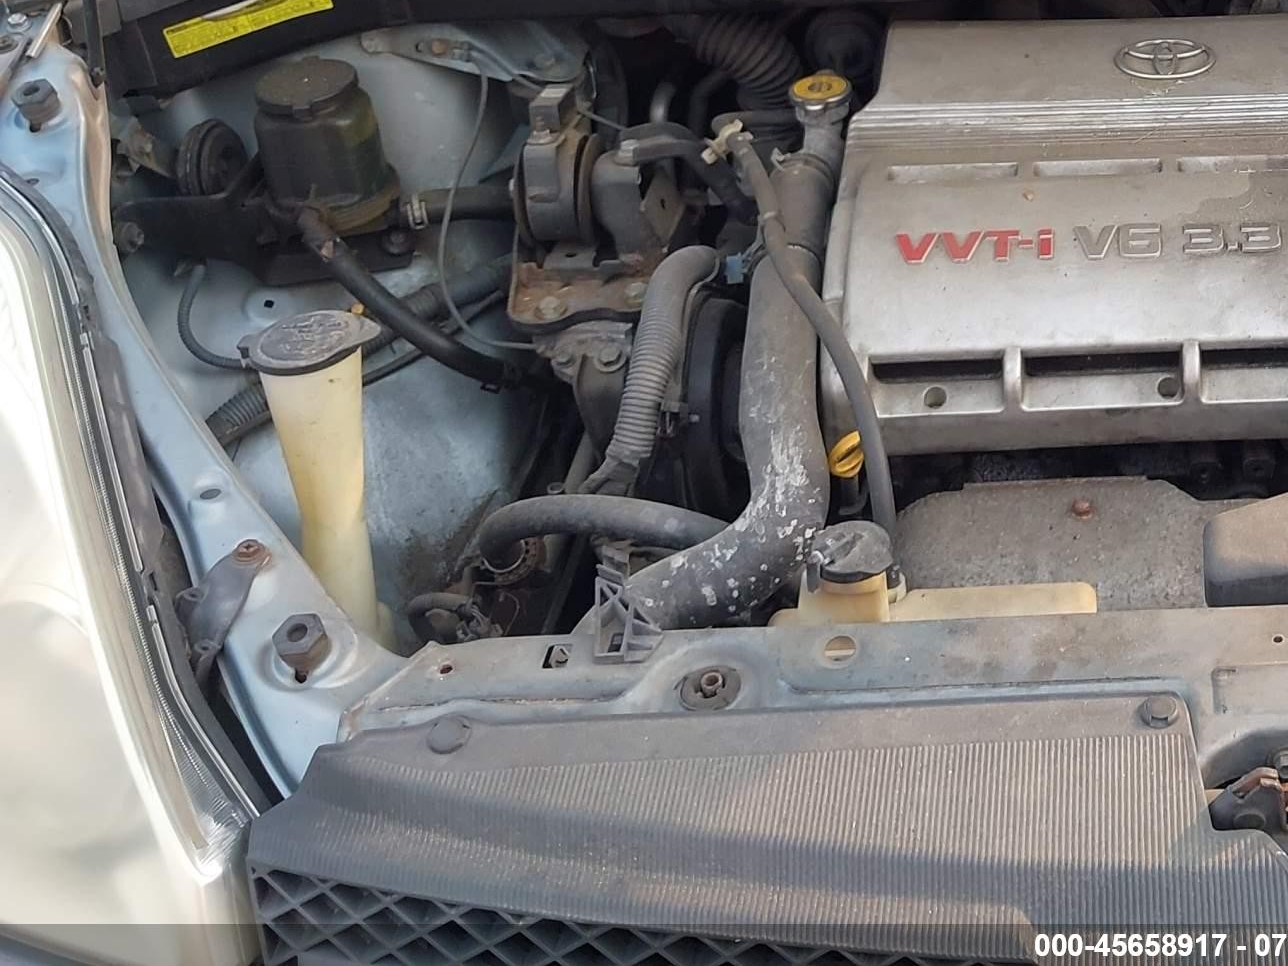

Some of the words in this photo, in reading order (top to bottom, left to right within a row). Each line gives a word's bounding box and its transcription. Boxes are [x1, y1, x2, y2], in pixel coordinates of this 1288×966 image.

[896, 227, 1054, 265] VVT-i
[1073, 224, 1163, 260] V6
[1181, 222, 1284, 256] 3.3
